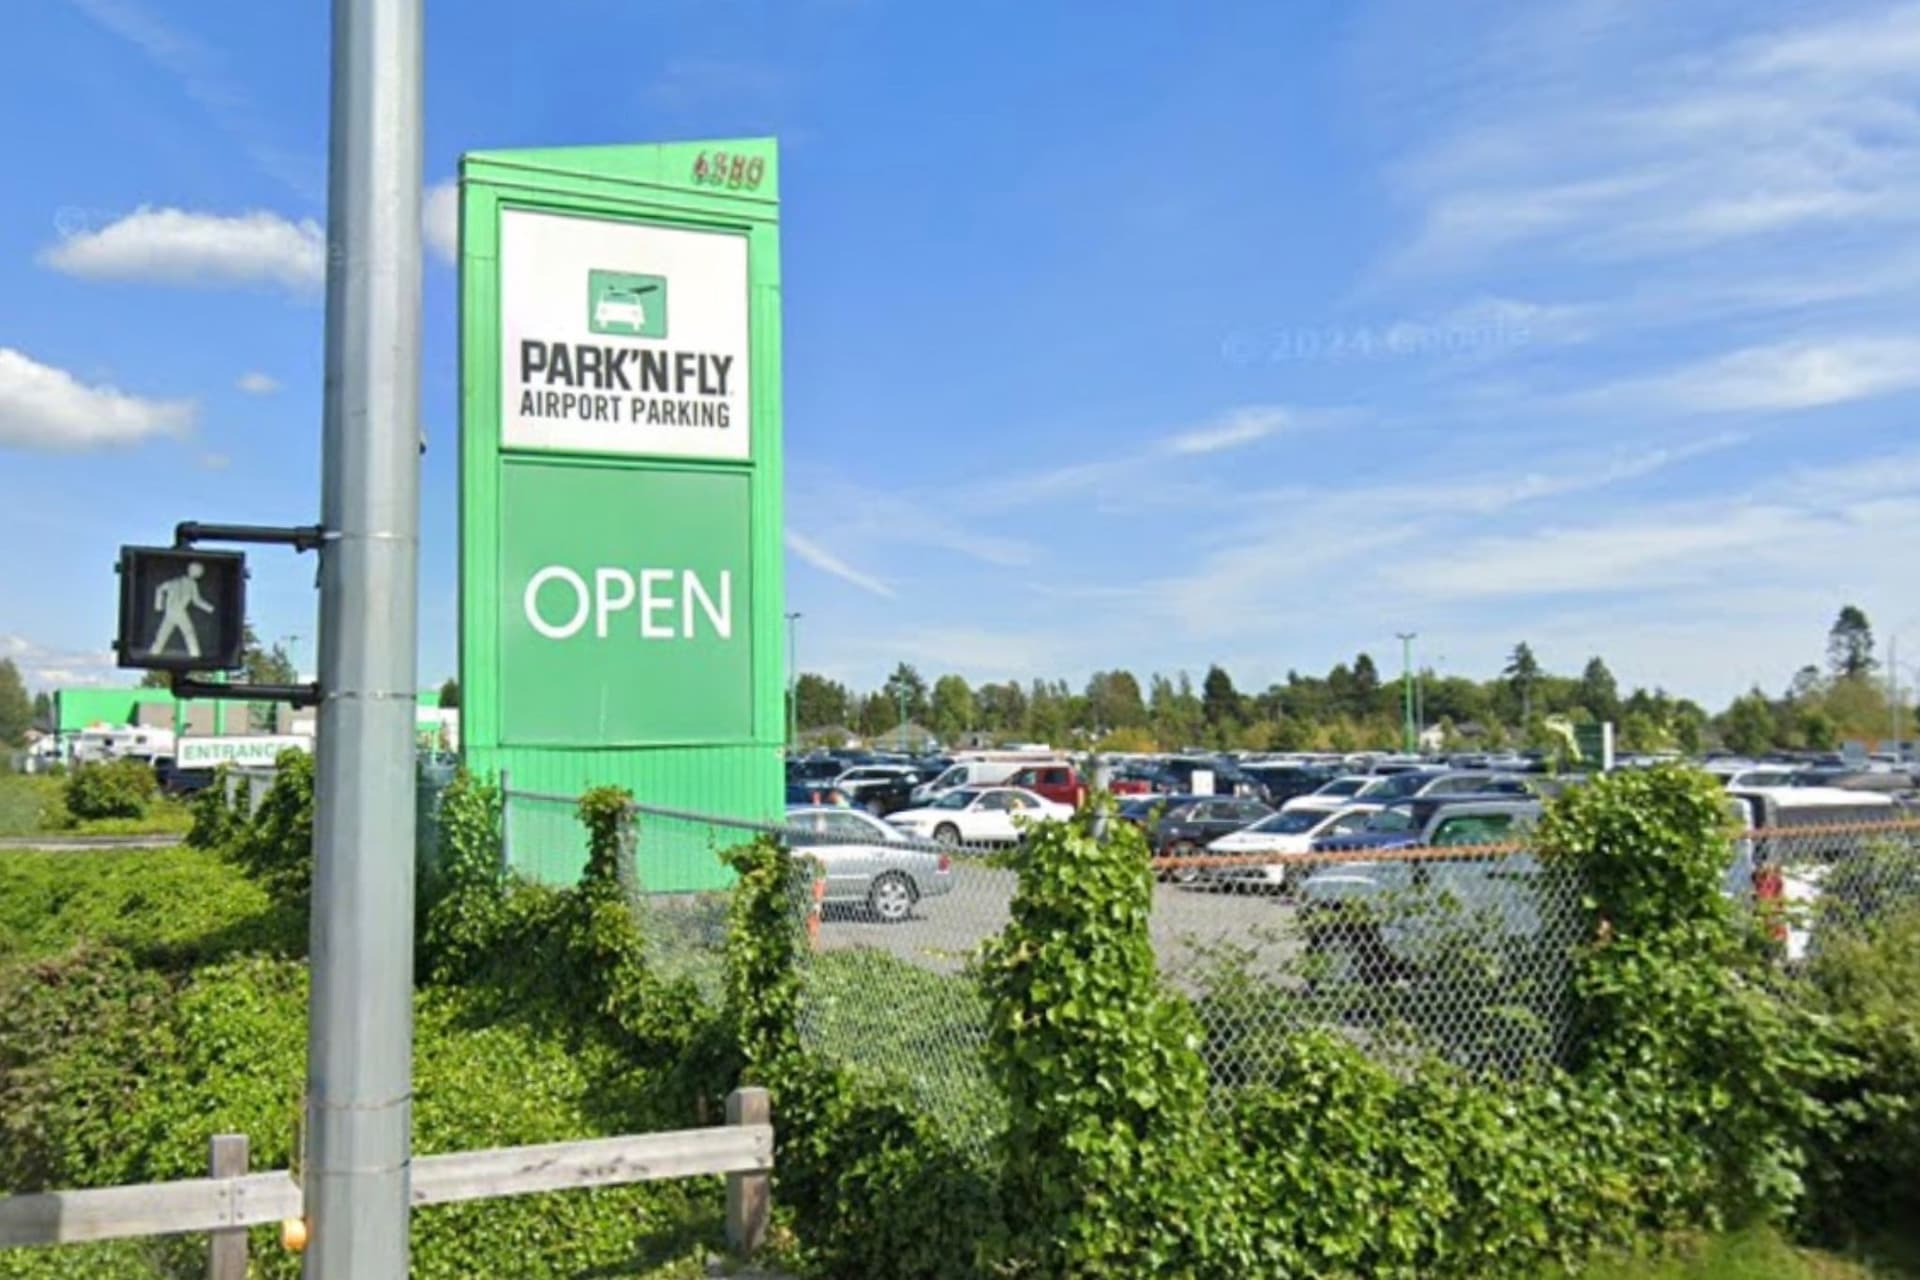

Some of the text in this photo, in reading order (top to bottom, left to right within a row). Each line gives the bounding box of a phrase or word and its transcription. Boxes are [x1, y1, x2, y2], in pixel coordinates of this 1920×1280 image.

[675, 351, 734, 396] FLY
[520, 389, 730, 428] AIRPORT PARKING
[524, 565, 731, 639] OPEN
